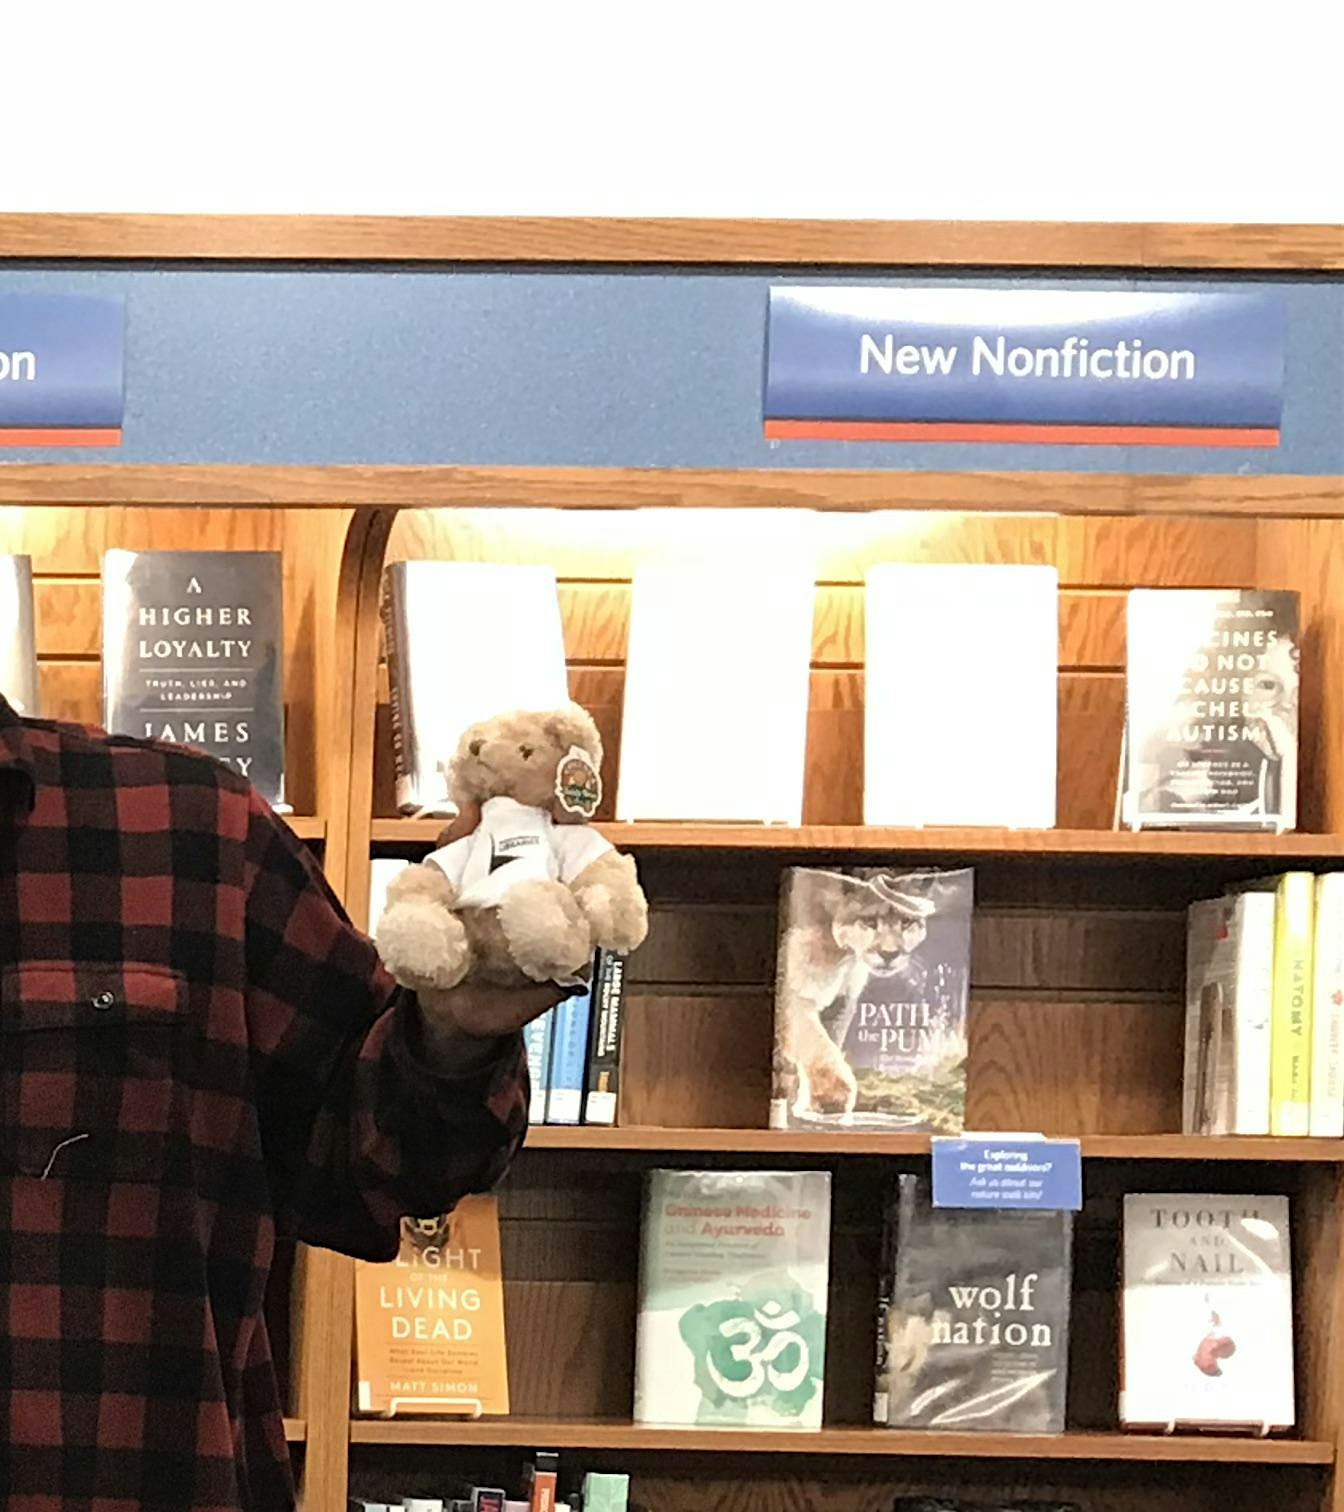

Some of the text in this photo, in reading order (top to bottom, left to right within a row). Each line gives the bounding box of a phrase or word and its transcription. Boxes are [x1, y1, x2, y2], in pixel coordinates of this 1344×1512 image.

[859, 334, 1195, 381] New Nonfiction
[187, 577, 202, 593] A
[139, 607, 252, 626] HIGHER
[139, 640, 252, 658] LOYALTY
[223, 679, 248, 688] AND
[144, 722, 250, 743] JAMES
[606, 961, 623, 1051] LARGE MAMMALS
[1291, 958, 1305, 1036] NATOMY
[858, 1030, 880, 1043] the
[702, 1222, 785, 1239] Ayurveda
[396, 1246, 482, 1270] LIGHT
[1170, 1252, 1244, 1274] NAIL
[380, 1286, 481, 1311] LIVING
[948, 1273, 1039, 1311] wolf
[391, 1316, 472, 1340] DEAD
[929, 1312, 1053, 1347] nation
[390, 1381, 479, 1394] MATT SIMON
